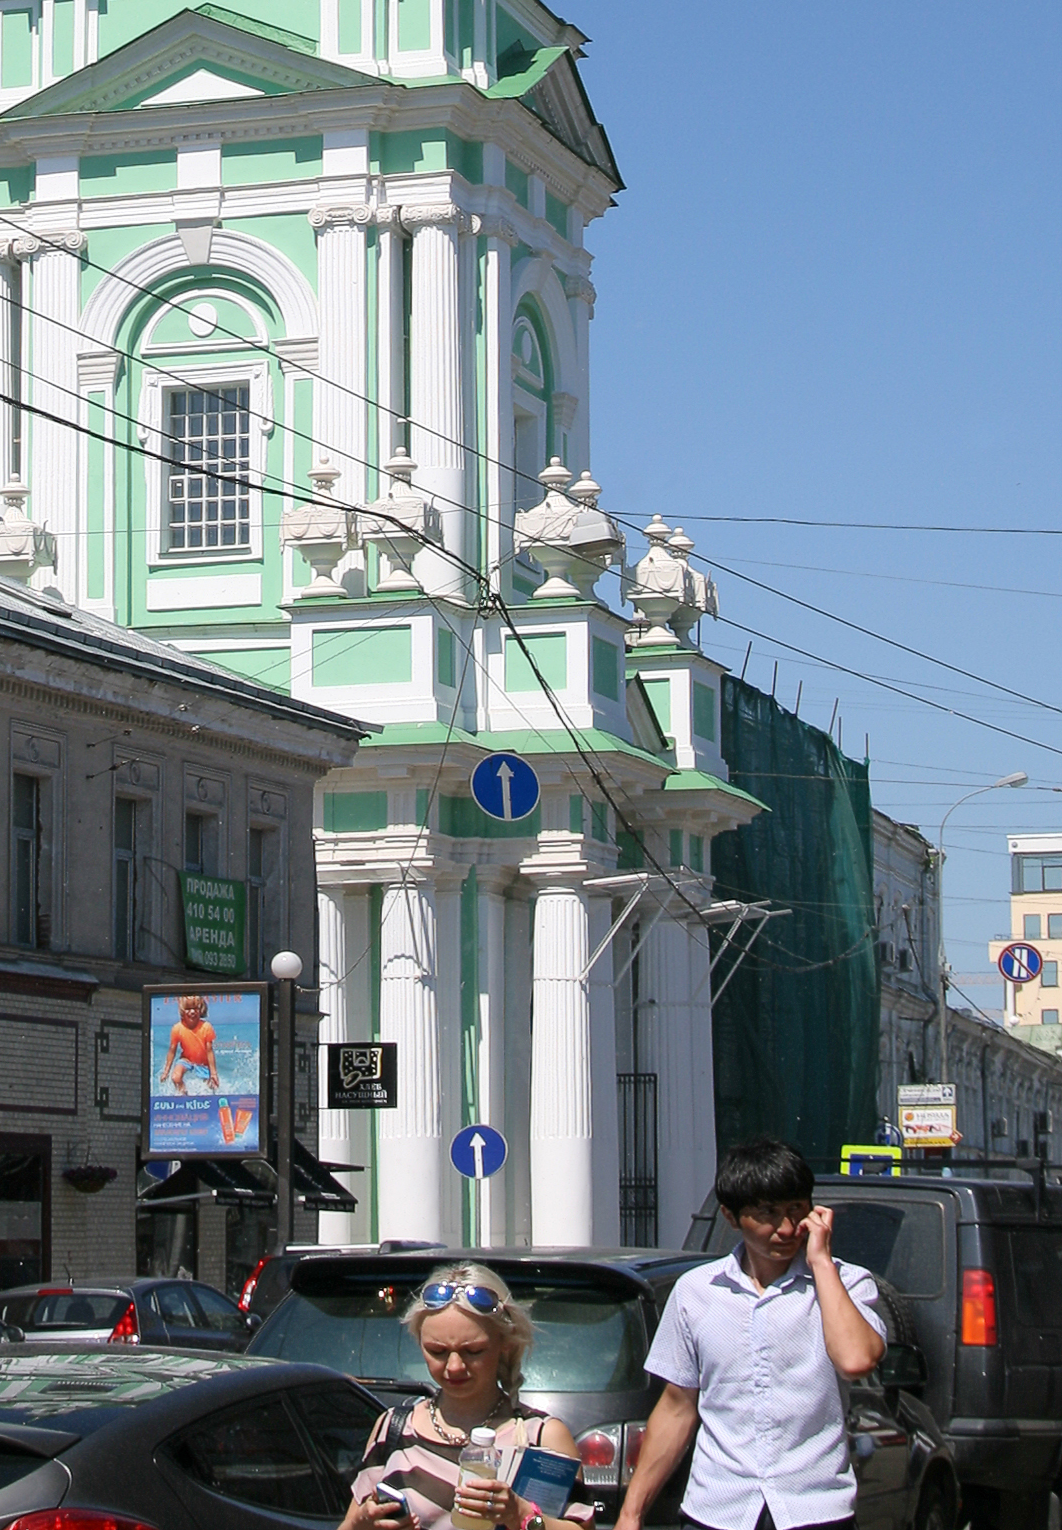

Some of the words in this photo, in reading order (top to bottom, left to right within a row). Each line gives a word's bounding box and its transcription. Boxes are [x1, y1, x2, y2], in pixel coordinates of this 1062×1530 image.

[186, 878, 235, 900] ПРОДАЖА
[187, 902, 205, 919] 410
[208, 905, 220, 921] 54
[223, 908, 235, 923] 00
[189, 926, 235, 948] АРЕНДА
[153, 1100, 175, 1110] SUN
[186, 1098, 210, 1110] KIDS
[335, 1090, 387, 1098] НАСУЩНЫЙ
